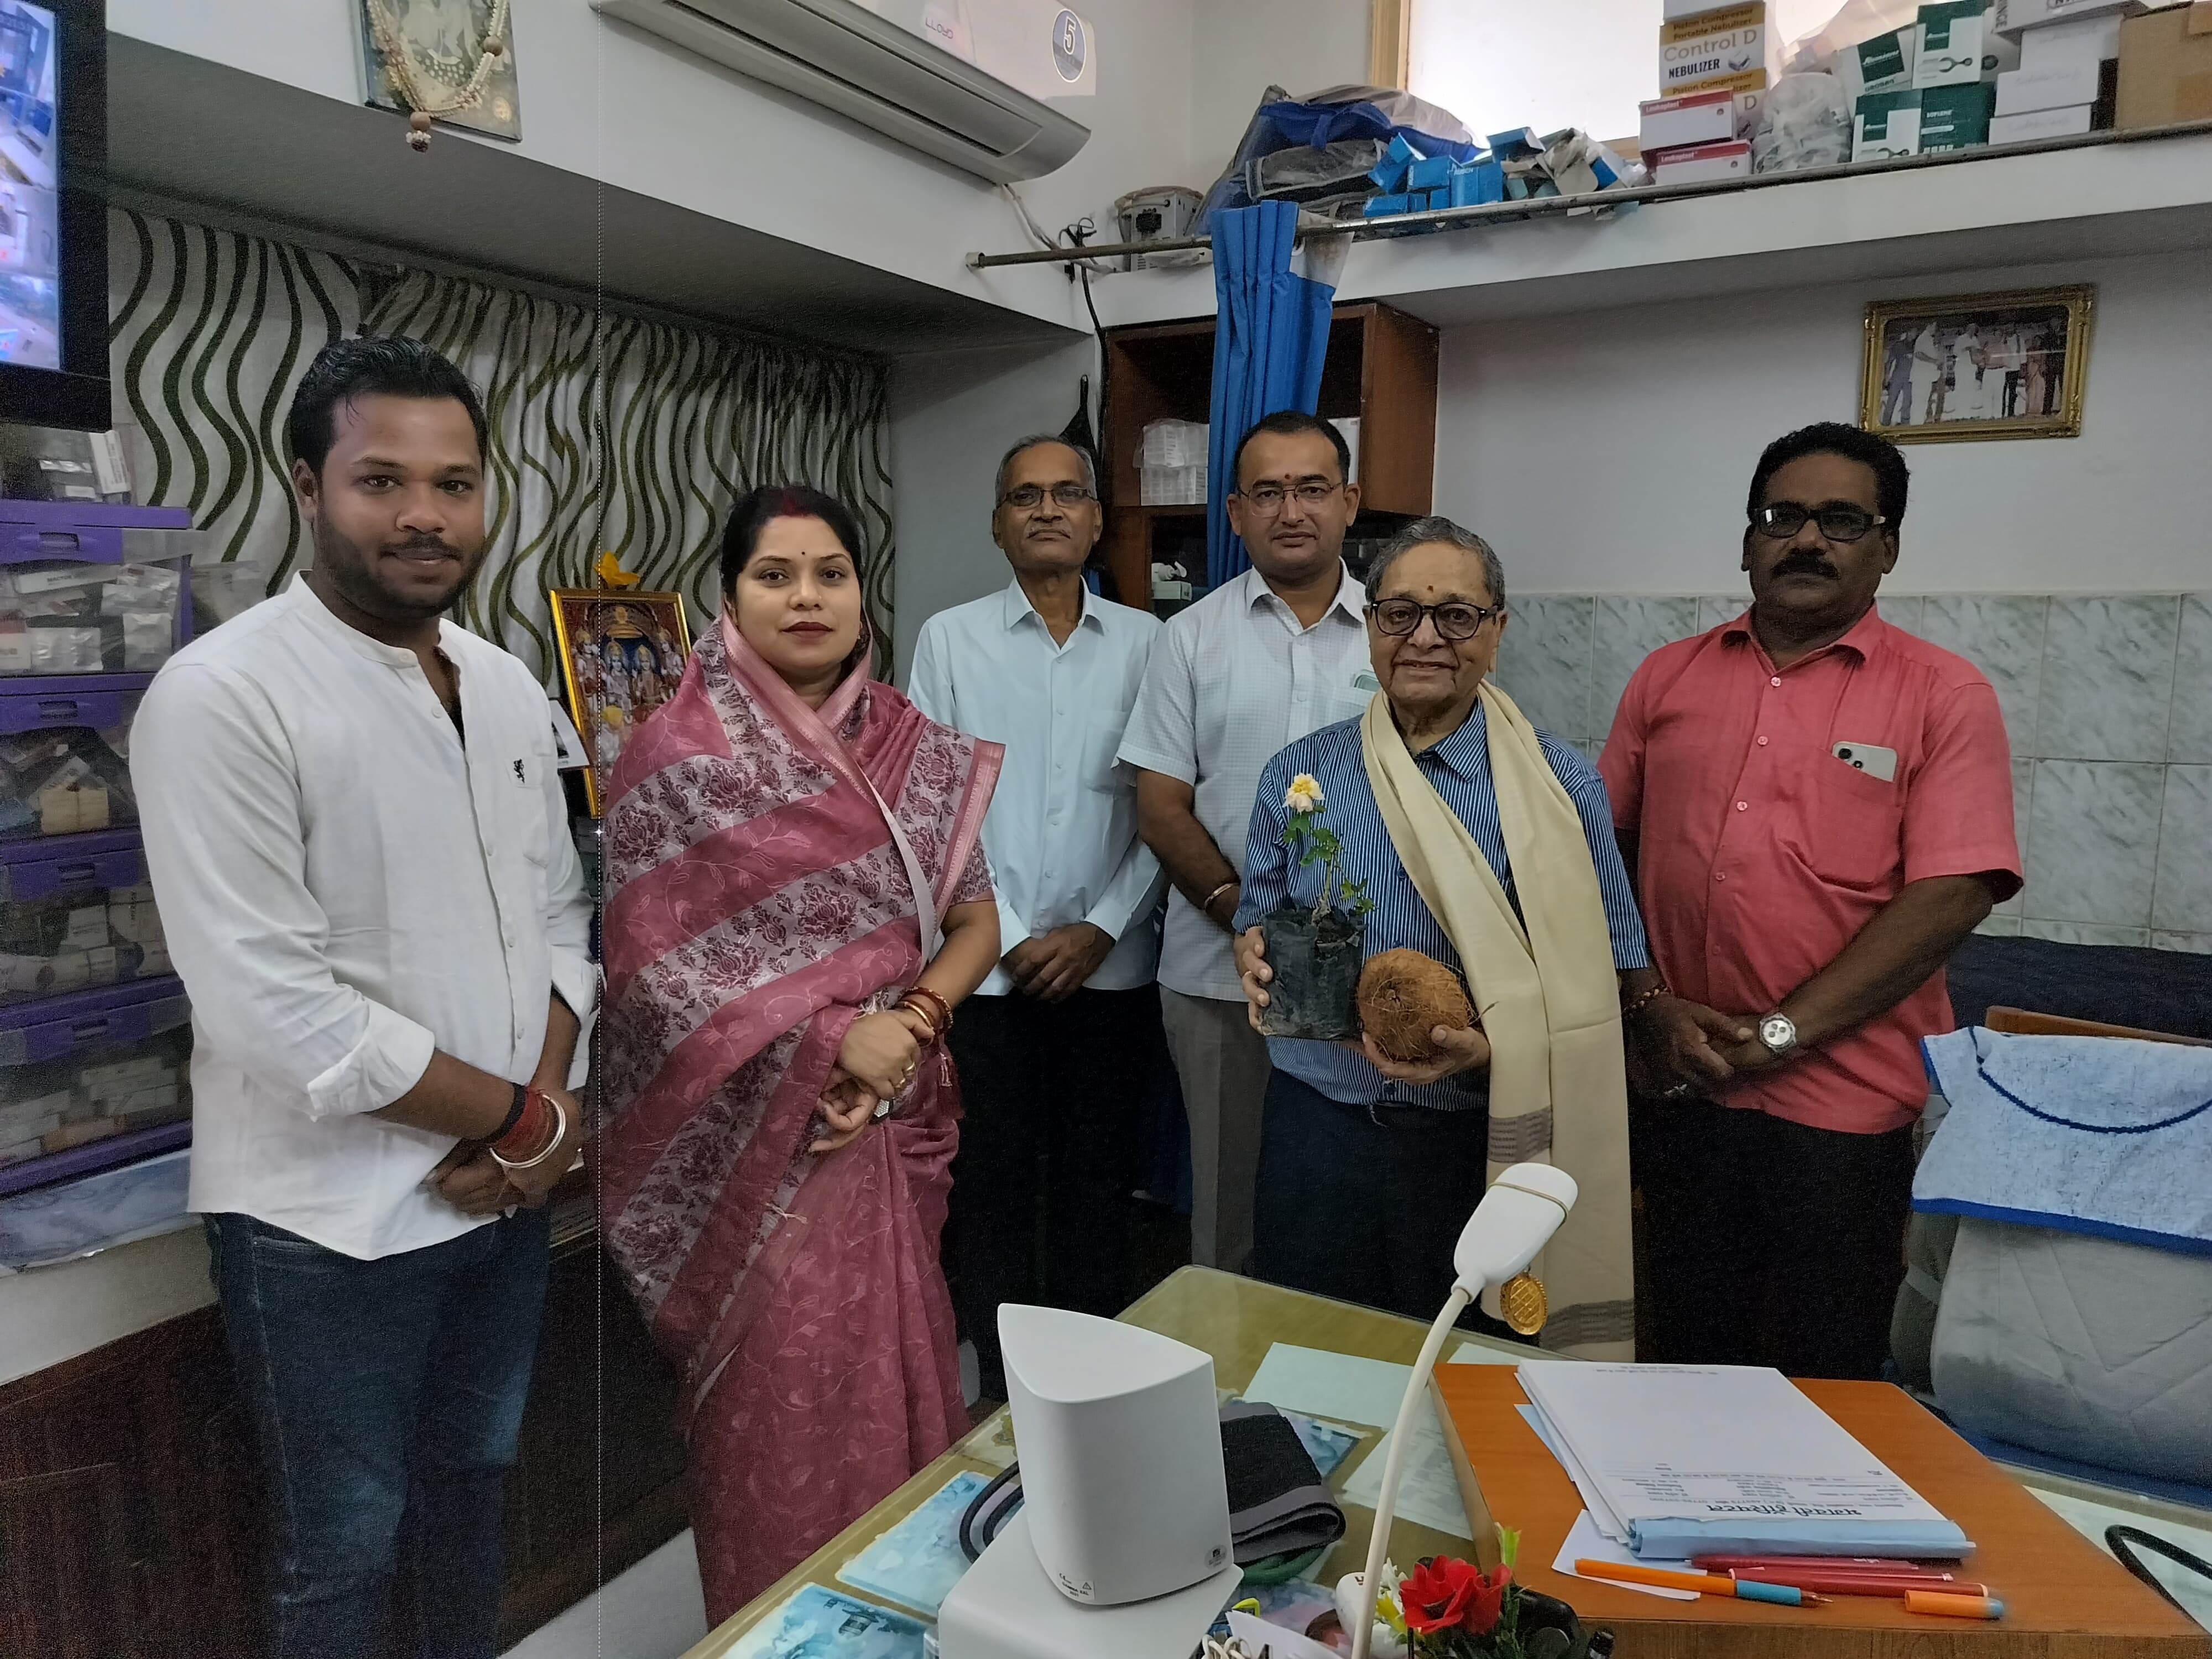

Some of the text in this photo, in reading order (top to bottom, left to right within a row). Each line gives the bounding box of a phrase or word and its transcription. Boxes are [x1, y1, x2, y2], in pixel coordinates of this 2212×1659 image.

[925, 17, 954, 39] LLOYD
[1673, 8, 1753, 31] Piston Compressor
[1674, 18, 1752, 40] Portable Nebulizer
[1063, 15, 1076, 55] 5
[1663, 29, 1757, 61] Control D
[1668, 59, 1720, 79] NEBULIZER
[1673, 74, 1752, 95] Piston Compressor
[1792, 1506, 1862, 1516] भगवती
